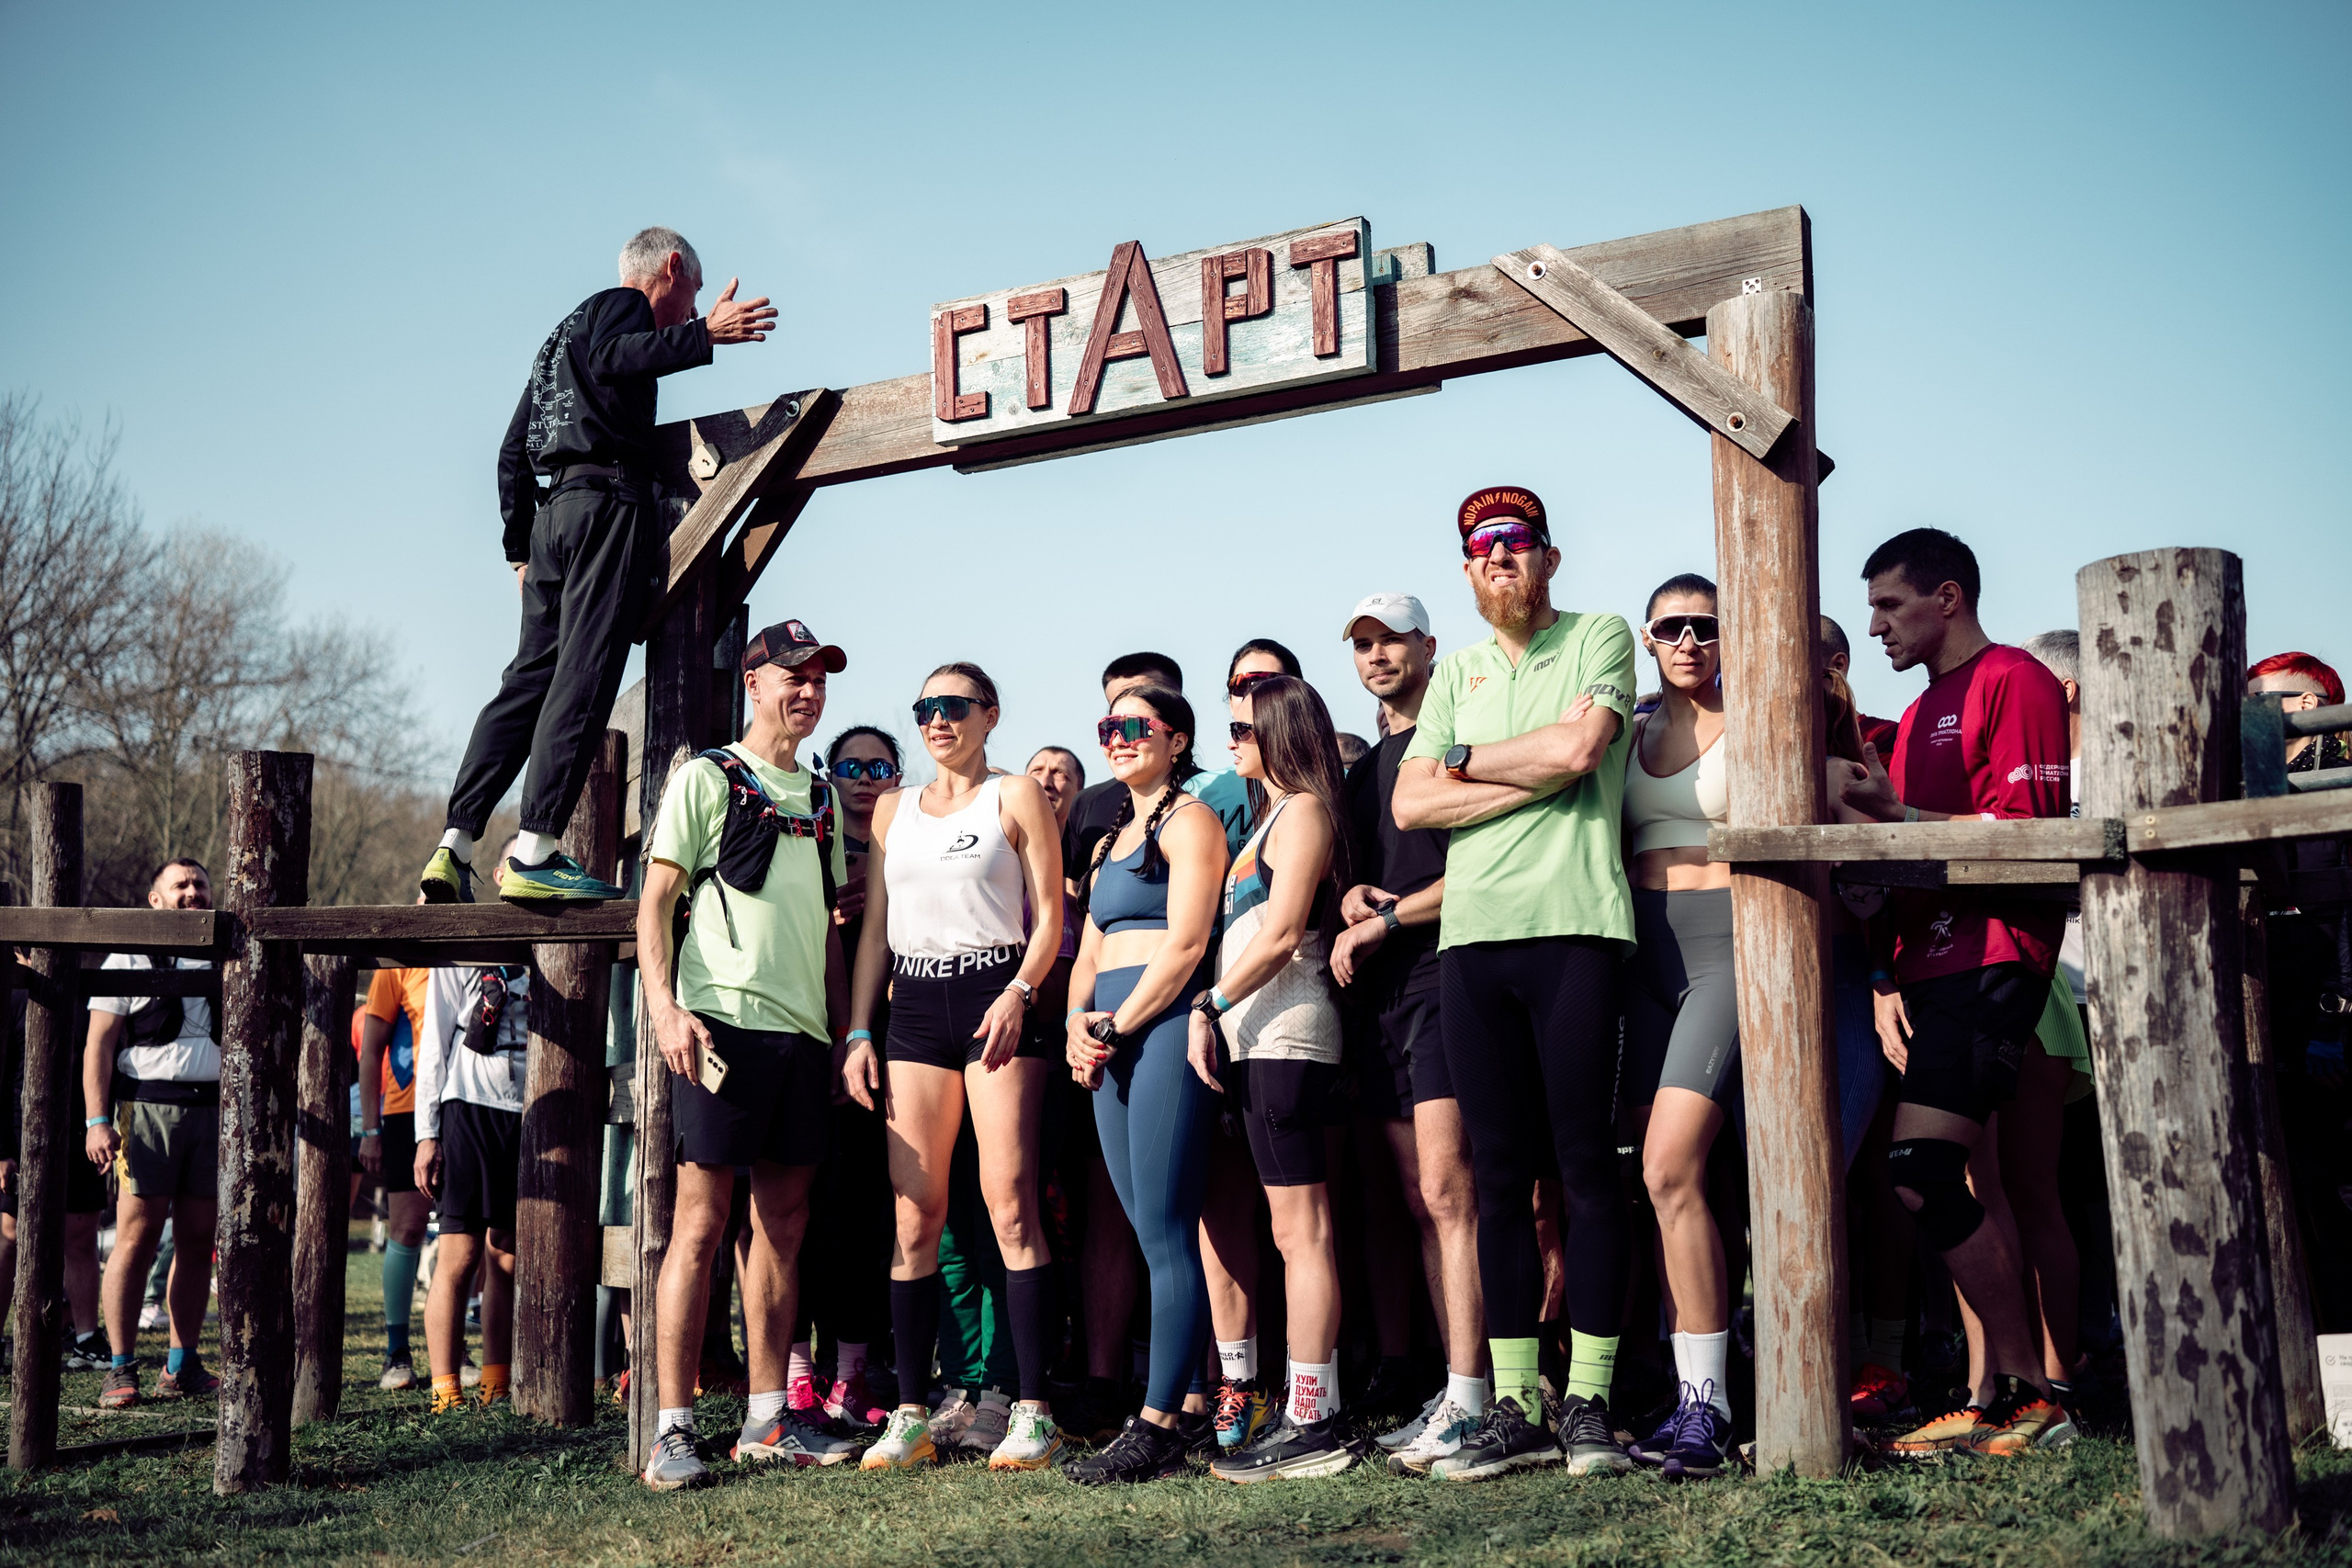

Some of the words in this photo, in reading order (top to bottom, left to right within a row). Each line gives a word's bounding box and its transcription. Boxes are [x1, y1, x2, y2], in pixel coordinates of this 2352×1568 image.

[933, 229, 1359, 422] СТАРТ
[899, 956, 954, 978] NIKE
[959, 945, 1011, 976] PRO
[1295, 1373, 1317, 1386] ХУЛИ
[1295, 1384, 1327, 1397] ДУМАТЬ
[1295, 1396, 1317, 1409] НАДО
[1294, 1406, 1322, 1421] БЕГАТЬ
